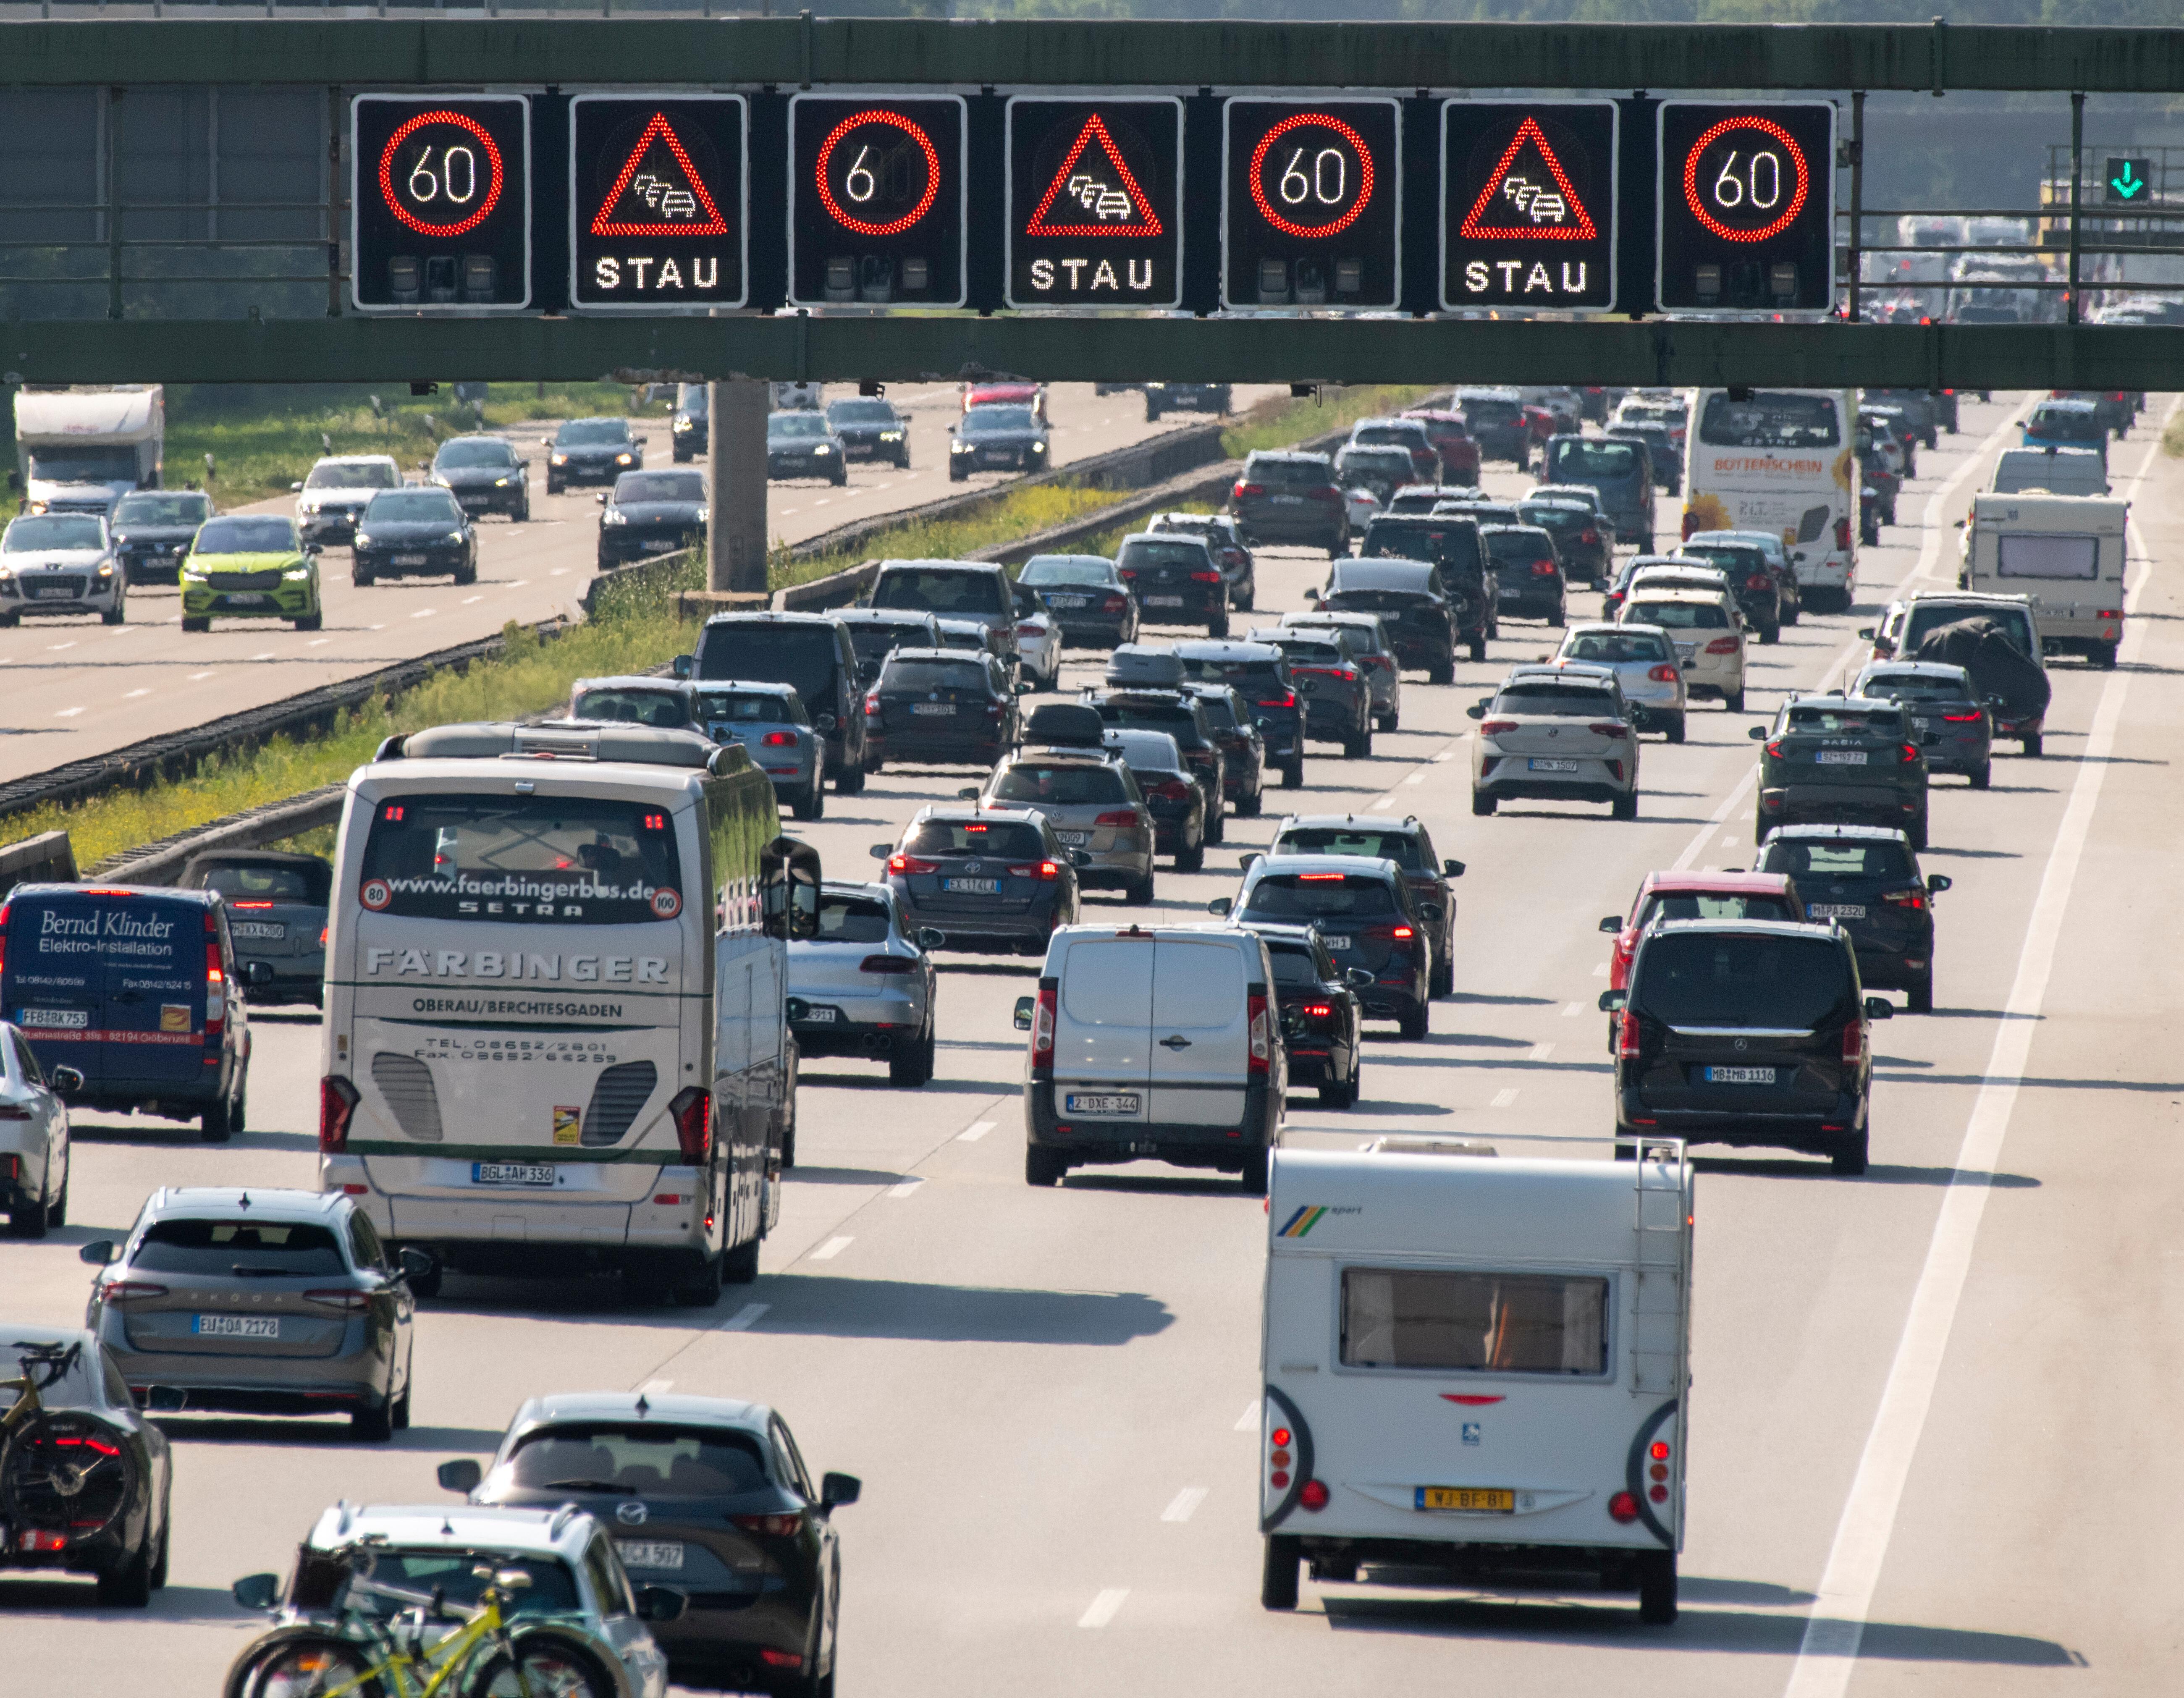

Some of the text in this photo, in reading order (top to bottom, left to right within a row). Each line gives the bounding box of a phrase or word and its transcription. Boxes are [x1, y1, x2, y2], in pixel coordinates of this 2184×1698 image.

[409, 145, 475, 202] 60
[1281, 147, 1345, 204] 60
[1715, 150, 1779, 208] 60
[596, 257, 718, 288] STAU
[1030, 259, 1153, 290] STAU
[1465, 261, 1587, 293] STAU
[367, 887, 384, 902] 80
[386, 873, 656, 903] www.faerbingerbus.de
[458, 901, 583, 917] SETRA
[656, 896, 675, 910] 100
[1841, 906, 1864, 917] 2320
[41, 909, 174, 938] Bernd Klinder
[39, 938, 172, 956] Elektro-Installation
[413, 998, 622, 1018] OBERAU/BERCHTESGADEN
[66, 1012, 87, 1025] 753
[1712, 1069, 1725, 1080] MB
[1732, 1069, 1746, 1080] MB
[481, 1166, 552, 1182] BGL AH 336
[245, 1319, 277, 1336] 2178
